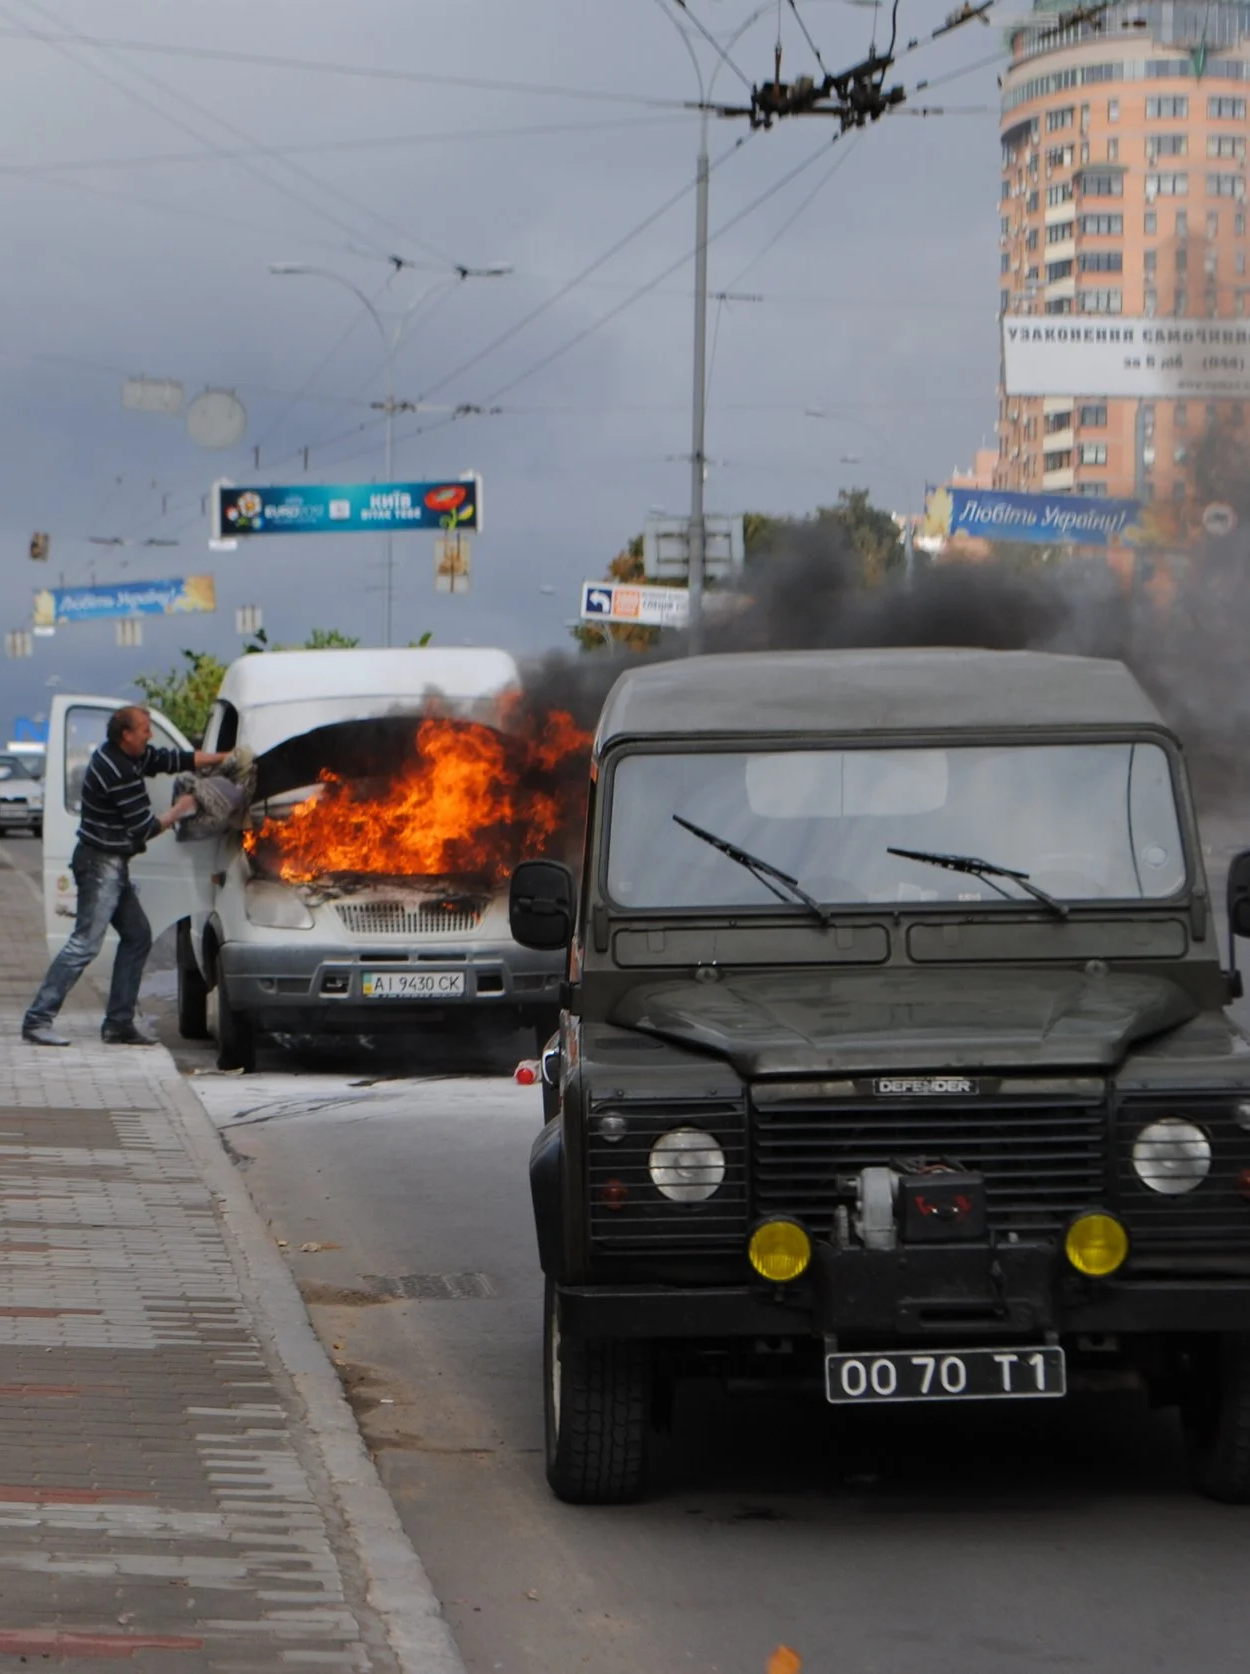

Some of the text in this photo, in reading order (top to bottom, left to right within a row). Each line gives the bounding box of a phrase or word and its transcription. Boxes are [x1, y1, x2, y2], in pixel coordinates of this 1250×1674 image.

[959, 499, 1126, 532] Любіть Україну!
[399, 976, 435, 991] 9430
[438, 975, 460, 991] CK
[879, 1080, 970, 1092] DEFENDER
[841, 1353, 1046, 1396] 00 70 T1
